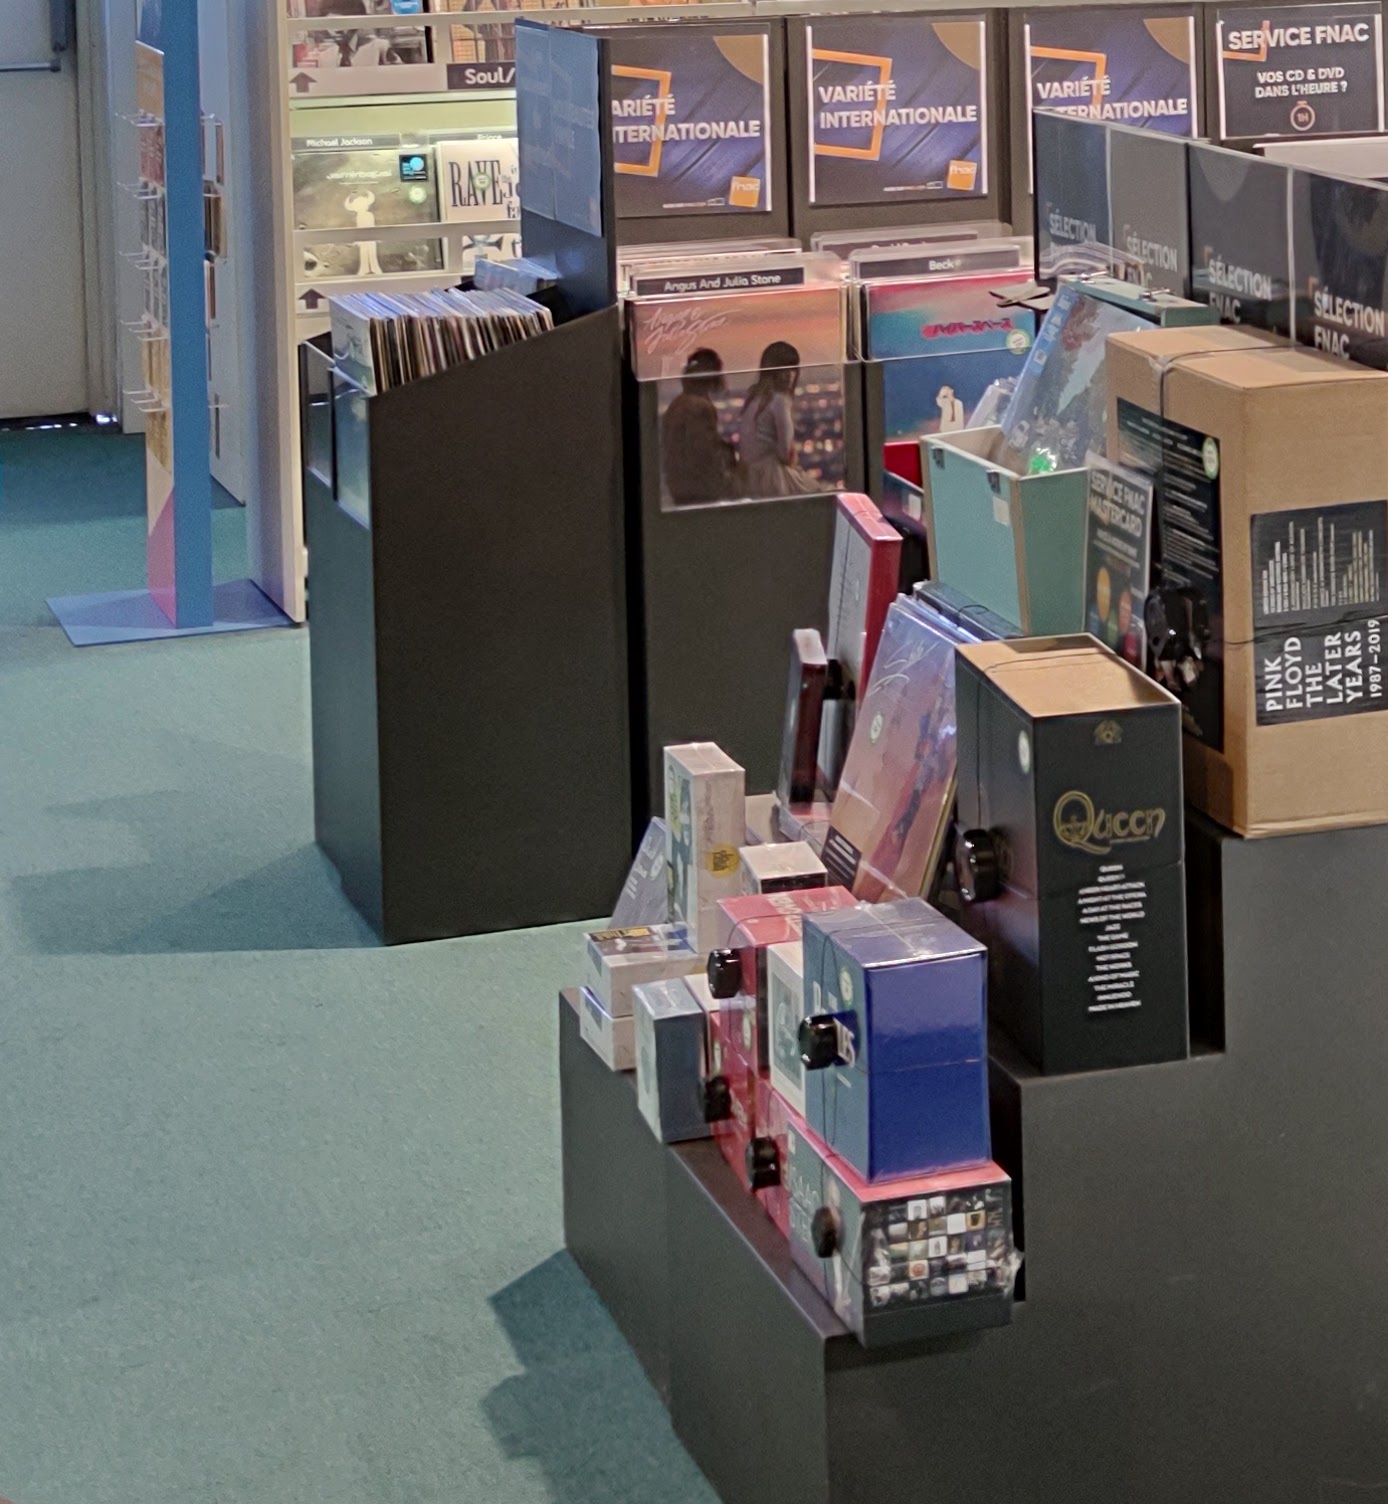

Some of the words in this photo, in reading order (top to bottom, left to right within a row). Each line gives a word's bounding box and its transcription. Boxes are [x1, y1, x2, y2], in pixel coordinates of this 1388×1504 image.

[1228, 26, 1312, 51] SERVICE
[1315, 22, 1370, 45] FNAC
[818, 79, 897, 104] VARIÉTÉ
[1036, 76, 1111, 100] VARIÉTÉ
[1255, 84, 1289, 99] DANS
[1291, 81, 1338, 97] L'HEURE
[1258, 70, 1285, 84] VOS
[1288, 69, 1305, 83] CD
[1318, 67, 1345, 80] DVD
[819, 104, 978, 130] INTERNATIONALE
[306, 137, 338, 147] Michael
[341, 137, 374, 147] Jackson
[447, 159, 502, 208] RAVE
[948, 163, 977, 176] fnac
[1048, 211, 1097, 243] SÉLECTION
[928, 259, 954, 271] Beck
[1127, 236, 1178, 273] SÉLECTION
[664, 279, 697, 292] Angus
[699, 277, 721, 289] And
[723, 275, 749, 287] Julia
[752, 273, 781, 286] Stone
[1208, 257, 1272, 302] SÉLECTION
[1209, 291, 1241, 323] FNAC
[1314, 288, 1385, 338] SÉLECTION
[1314, 329, 1350, 360] FNAC
[1284, 636, 1303, 709] FLOYD
[1325, 631, 1344, 704] LATER
[1345, 630, 1363, 704] YEARS
[1264, 656, 1283, 711] PINK
[1305, 662, 1323, 708] THE
[1053, 790, 1166, 855] Queen
